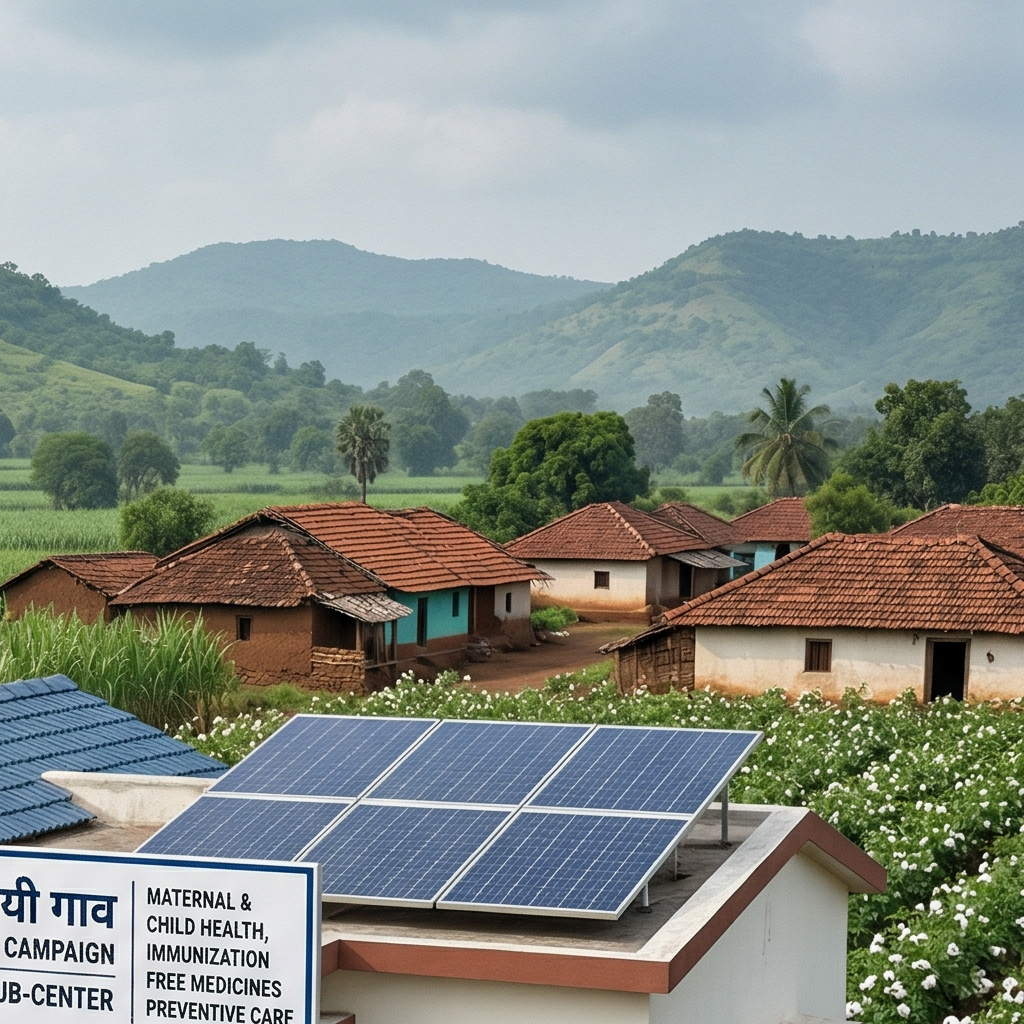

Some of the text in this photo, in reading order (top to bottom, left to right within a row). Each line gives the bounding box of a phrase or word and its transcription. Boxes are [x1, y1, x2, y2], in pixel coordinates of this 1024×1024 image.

[50, 892, 118, 928] गाव
[147, 887, 251, 911] MATERNAL &
[147, 916, 268, 944] CHILD HEALTH,
[5, 937, 114, 964] CAMPAIGN
[147, 943, 269, 968] IMMUNIZATION
[147, 972, 281, 998] FREE MEDICINES
[147, 999, 245, 1023] PREVENTIVE
